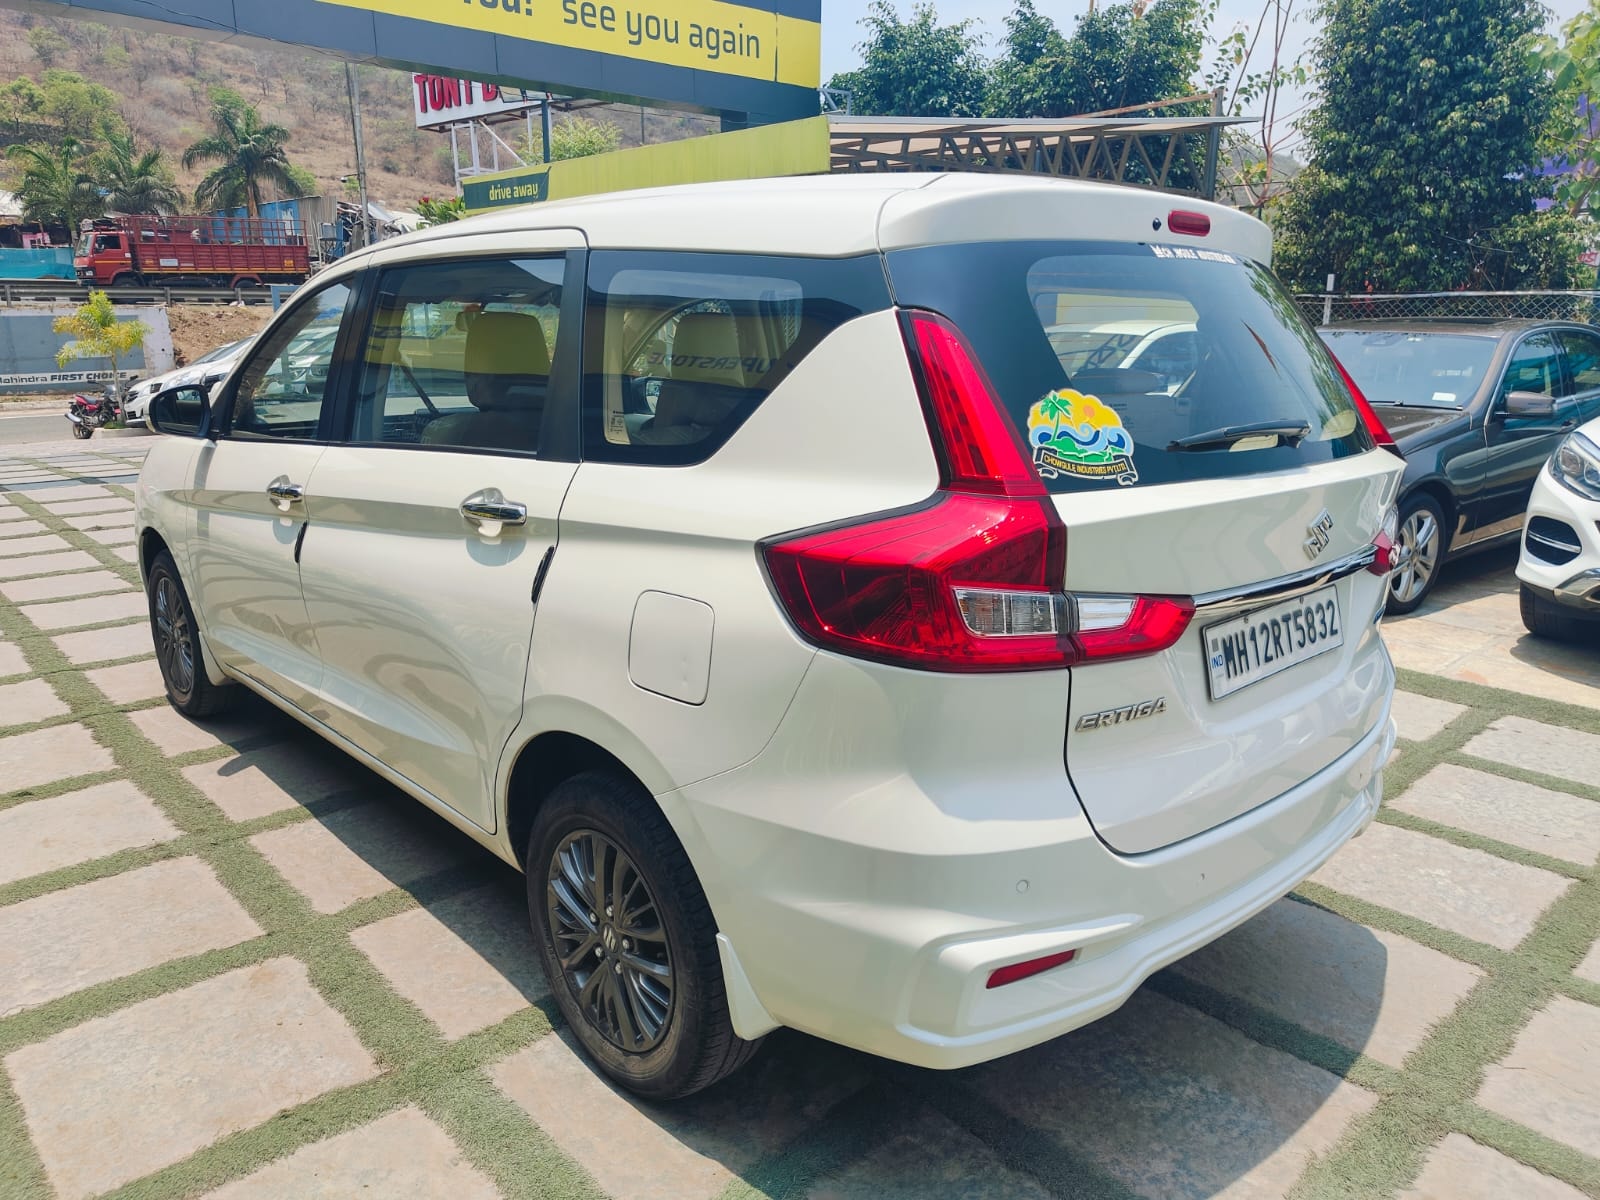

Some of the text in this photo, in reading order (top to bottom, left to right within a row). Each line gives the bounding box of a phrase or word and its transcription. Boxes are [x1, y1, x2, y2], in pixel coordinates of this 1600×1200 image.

[562, 0, 616, 32] see
[626, 10, 679, 46] you
[689, 23, 760, 60] again
[489, 183, 538, 201] drive away
[50, 373, 84, 382] FIRST
[1222, 599, 1339, 679] MH12RT5832
[1211, 654, 1224, 670] IND
[1075, 696, 1167, 732] ERTIGA
